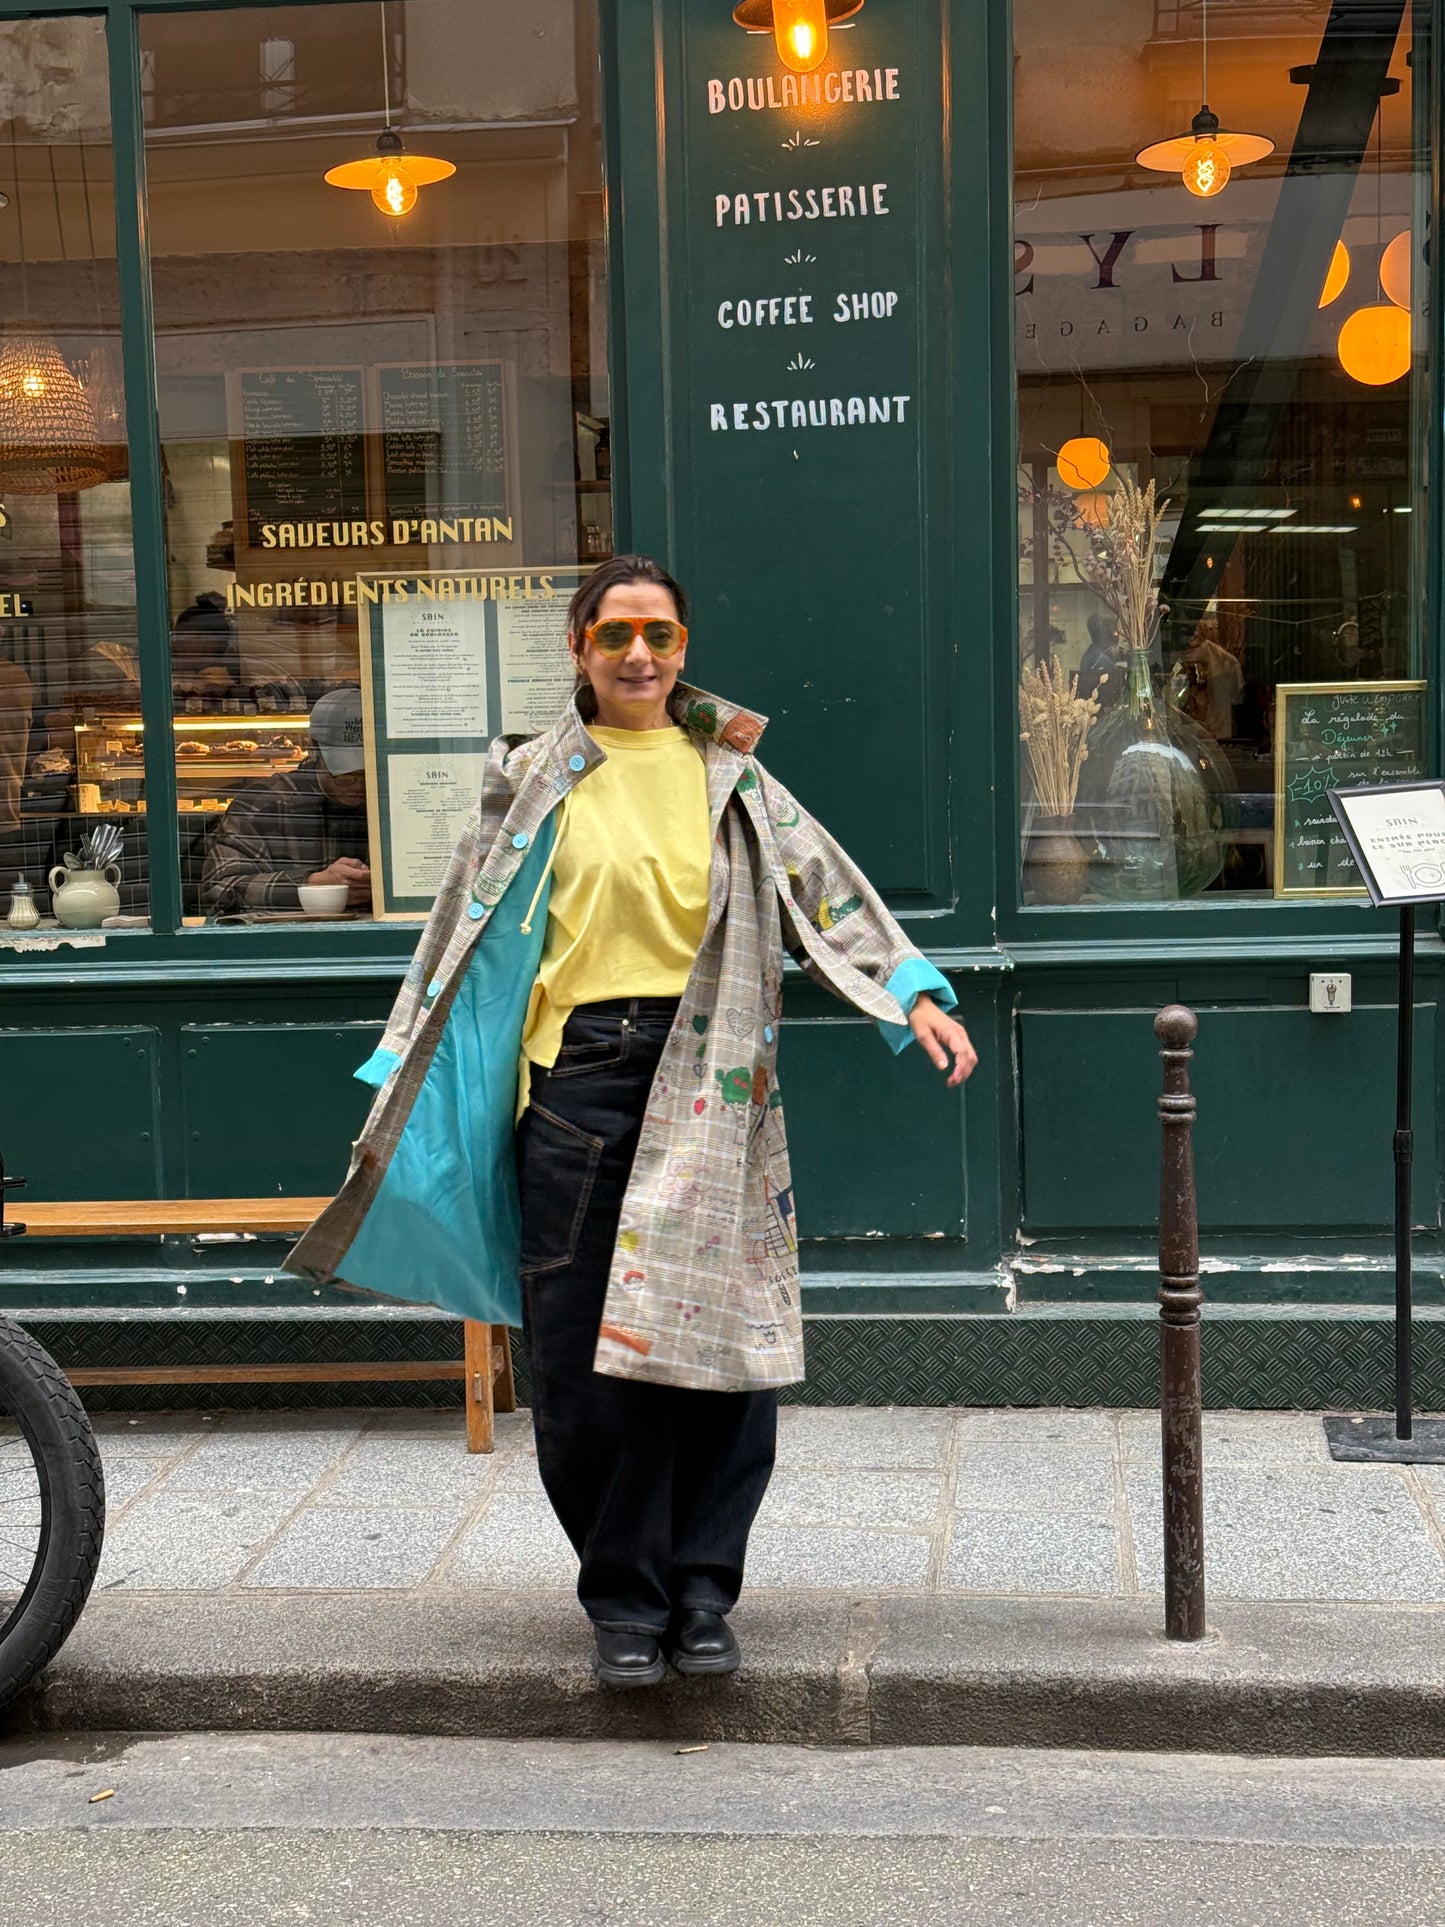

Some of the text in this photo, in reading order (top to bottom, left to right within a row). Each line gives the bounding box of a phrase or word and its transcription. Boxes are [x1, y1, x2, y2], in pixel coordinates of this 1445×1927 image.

[707, 68, 901, 114] BOULANGERIE
[715, 183, 890, 228] PATISSERIE
[717, 291, 899, 329] COFFEE SHOP
[710, 396, 911, 431] RESTAURANT
[262, 516, 513, 548] SAVEURS D'ANTAN
[227, 574, 554, 609] INGRÉDIENTS NATURELS
[421, 613, 444, 621] SAIN
[1301, 708, 1320, 725] La
[1321, 728, 1376, 751] Déjeuner
[424, 771, 449, 779] SAIN
[1292, 774, 1332, 796] -10%
[1385, 816, 1419, 827] SAIN
[1369, 833, 1412, 844] ENTRÉE
[1389, 841, 1412, 849] SUR
